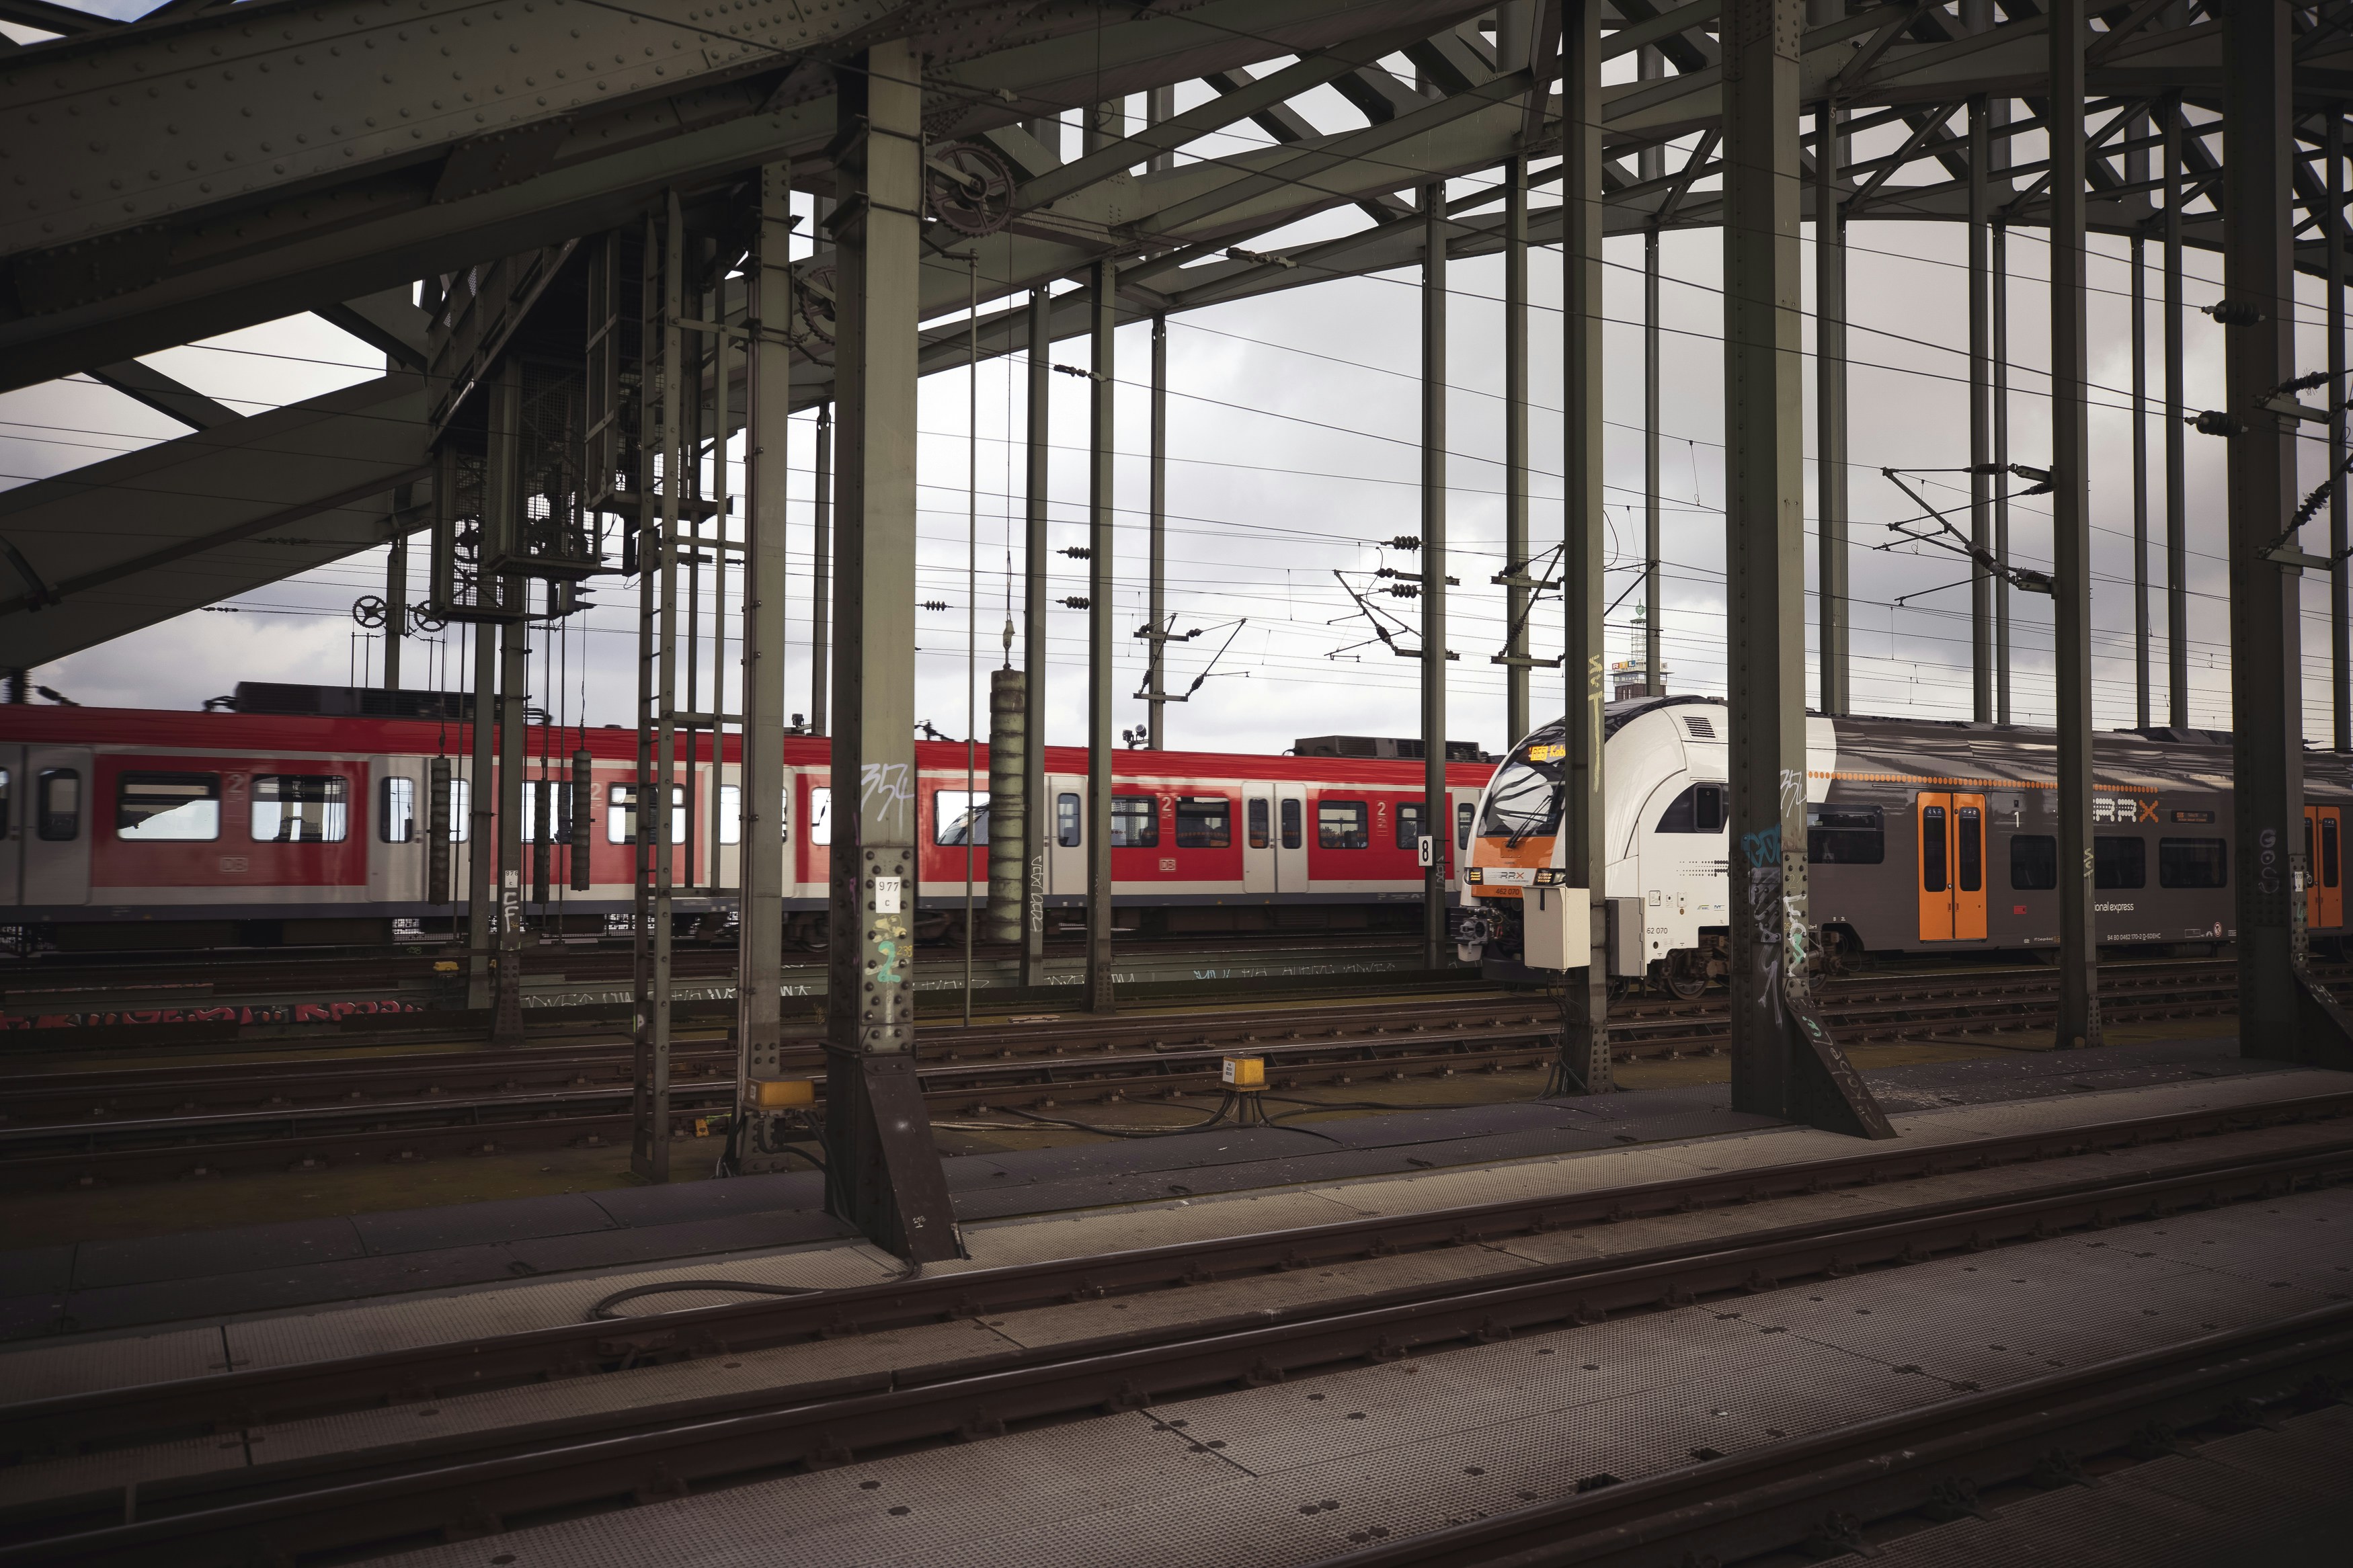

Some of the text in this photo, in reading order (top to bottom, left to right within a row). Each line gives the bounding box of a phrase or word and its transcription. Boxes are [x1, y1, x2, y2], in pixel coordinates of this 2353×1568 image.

[1830, 107, 1837, 119] 5
[1612, 660, 1636, 669] RTL
[227, 774, 243, 794] 2
[591, 782, 603, 800] 2
[1161, 796, 1172, 812] 2
[1377, 802, 1387, 816] 2
[2013, 811, 2020, 828] 1
[1422, 839, 1429, 862] 8
[1160, 859, 1175, 870] DB
[1500, 871, 1525, 880] RRX
[879, 881, 899, 893] 977
[2110, 903, 2135, 914] express
[877, 941, 902, 983] 2
